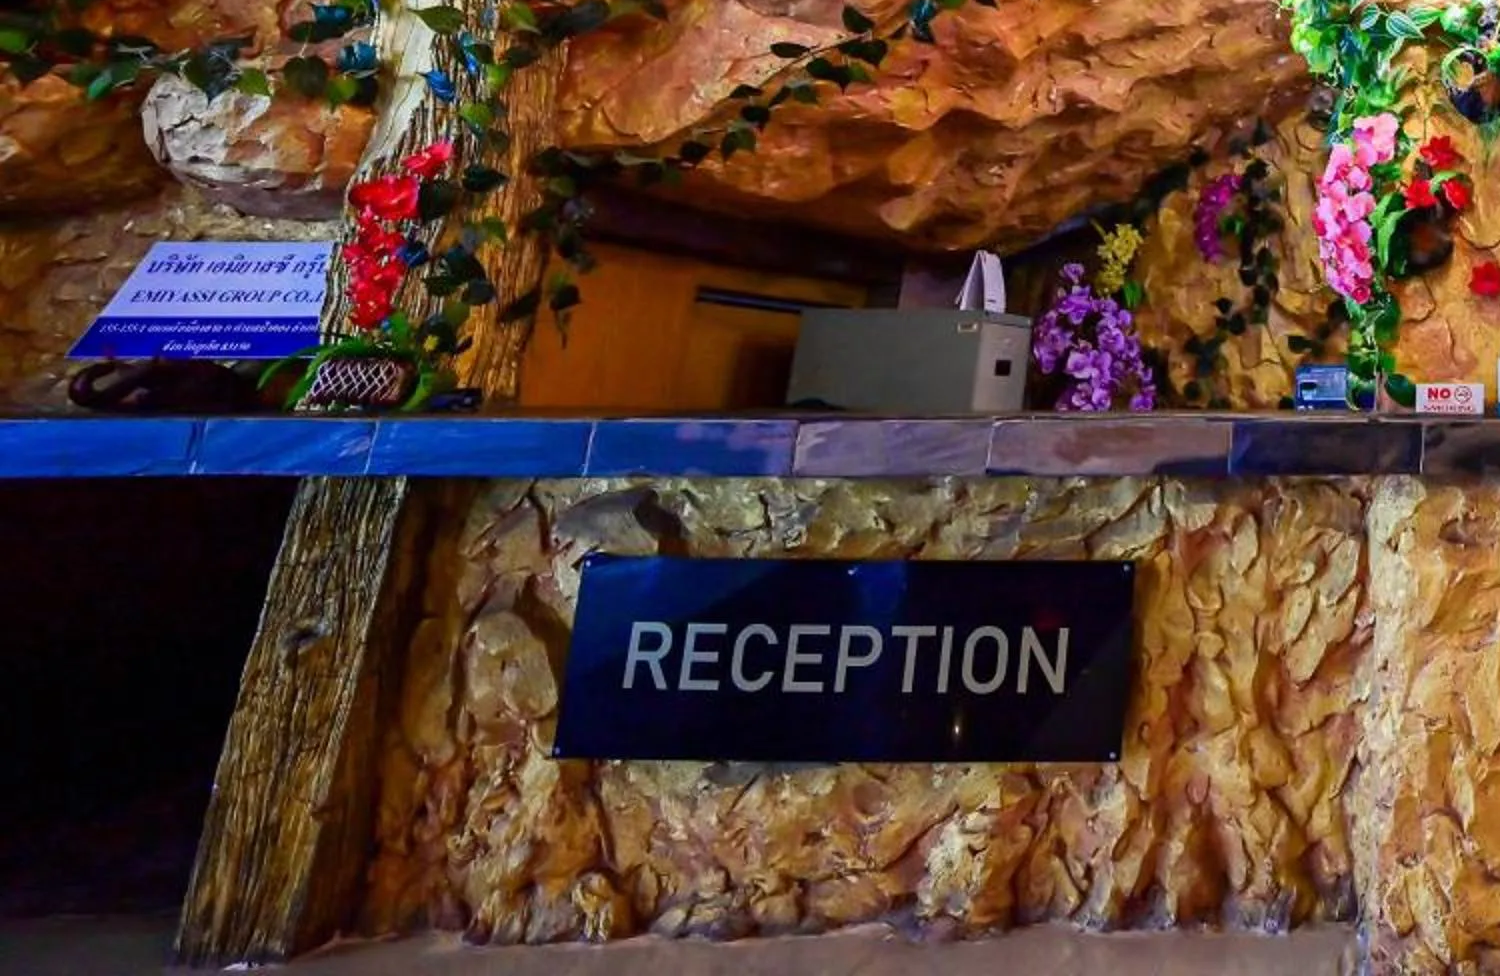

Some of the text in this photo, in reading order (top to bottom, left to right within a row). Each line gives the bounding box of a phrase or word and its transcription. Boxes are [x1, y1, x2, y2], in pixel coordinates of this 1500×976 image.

[130, 290, 217, 303] EMIYASSI
[218, 290, 282, 303] GROUP
[1427, 387, 1451, 399] NO
[621, 620, 1071, 695] RECEPTION
